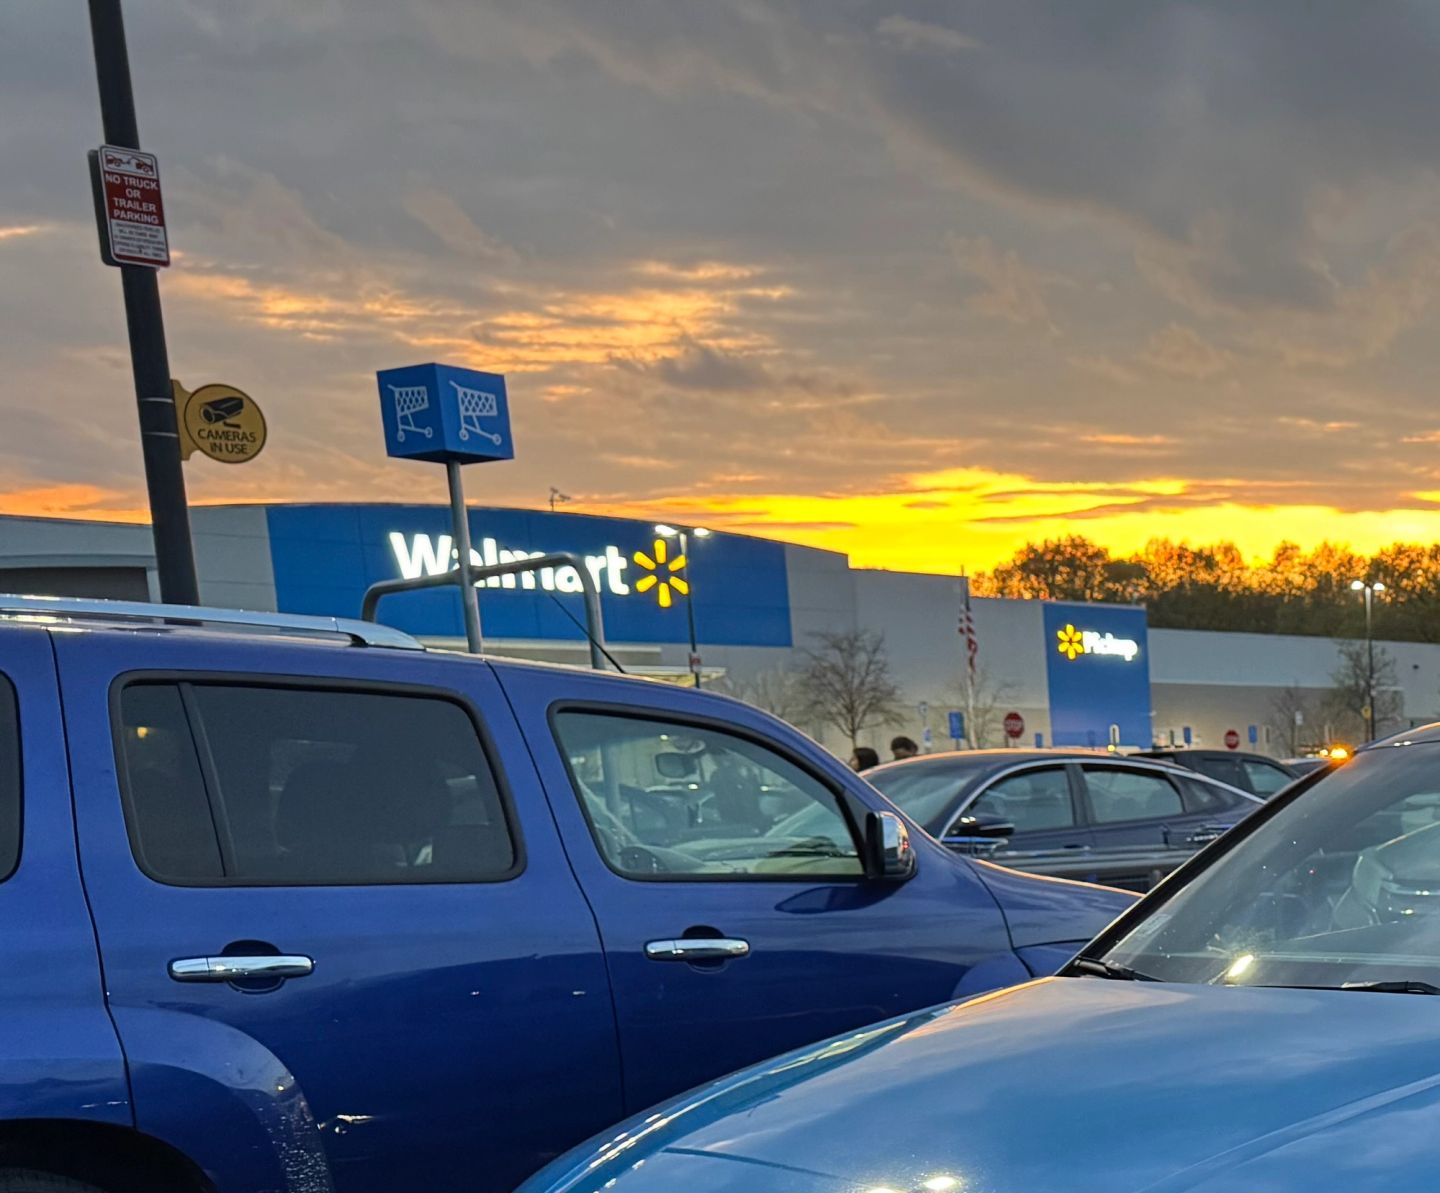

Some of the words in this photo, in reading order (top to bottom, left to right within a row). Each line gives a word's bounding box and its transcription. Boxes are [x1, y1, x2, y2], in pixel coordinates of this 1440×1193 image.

[105, 173, 121, 185] NO
[123, 176, 159, 190] TRUCK
[125, 188, 142, 199] OR
[112, 197, 157, 213] TRAILER
[113, 209, 159, 224] PARKING
[197, 429, 256, 443] CAMERAS
[209, 442, 223, 453] IN
[225, 443, 248, 454] USE
